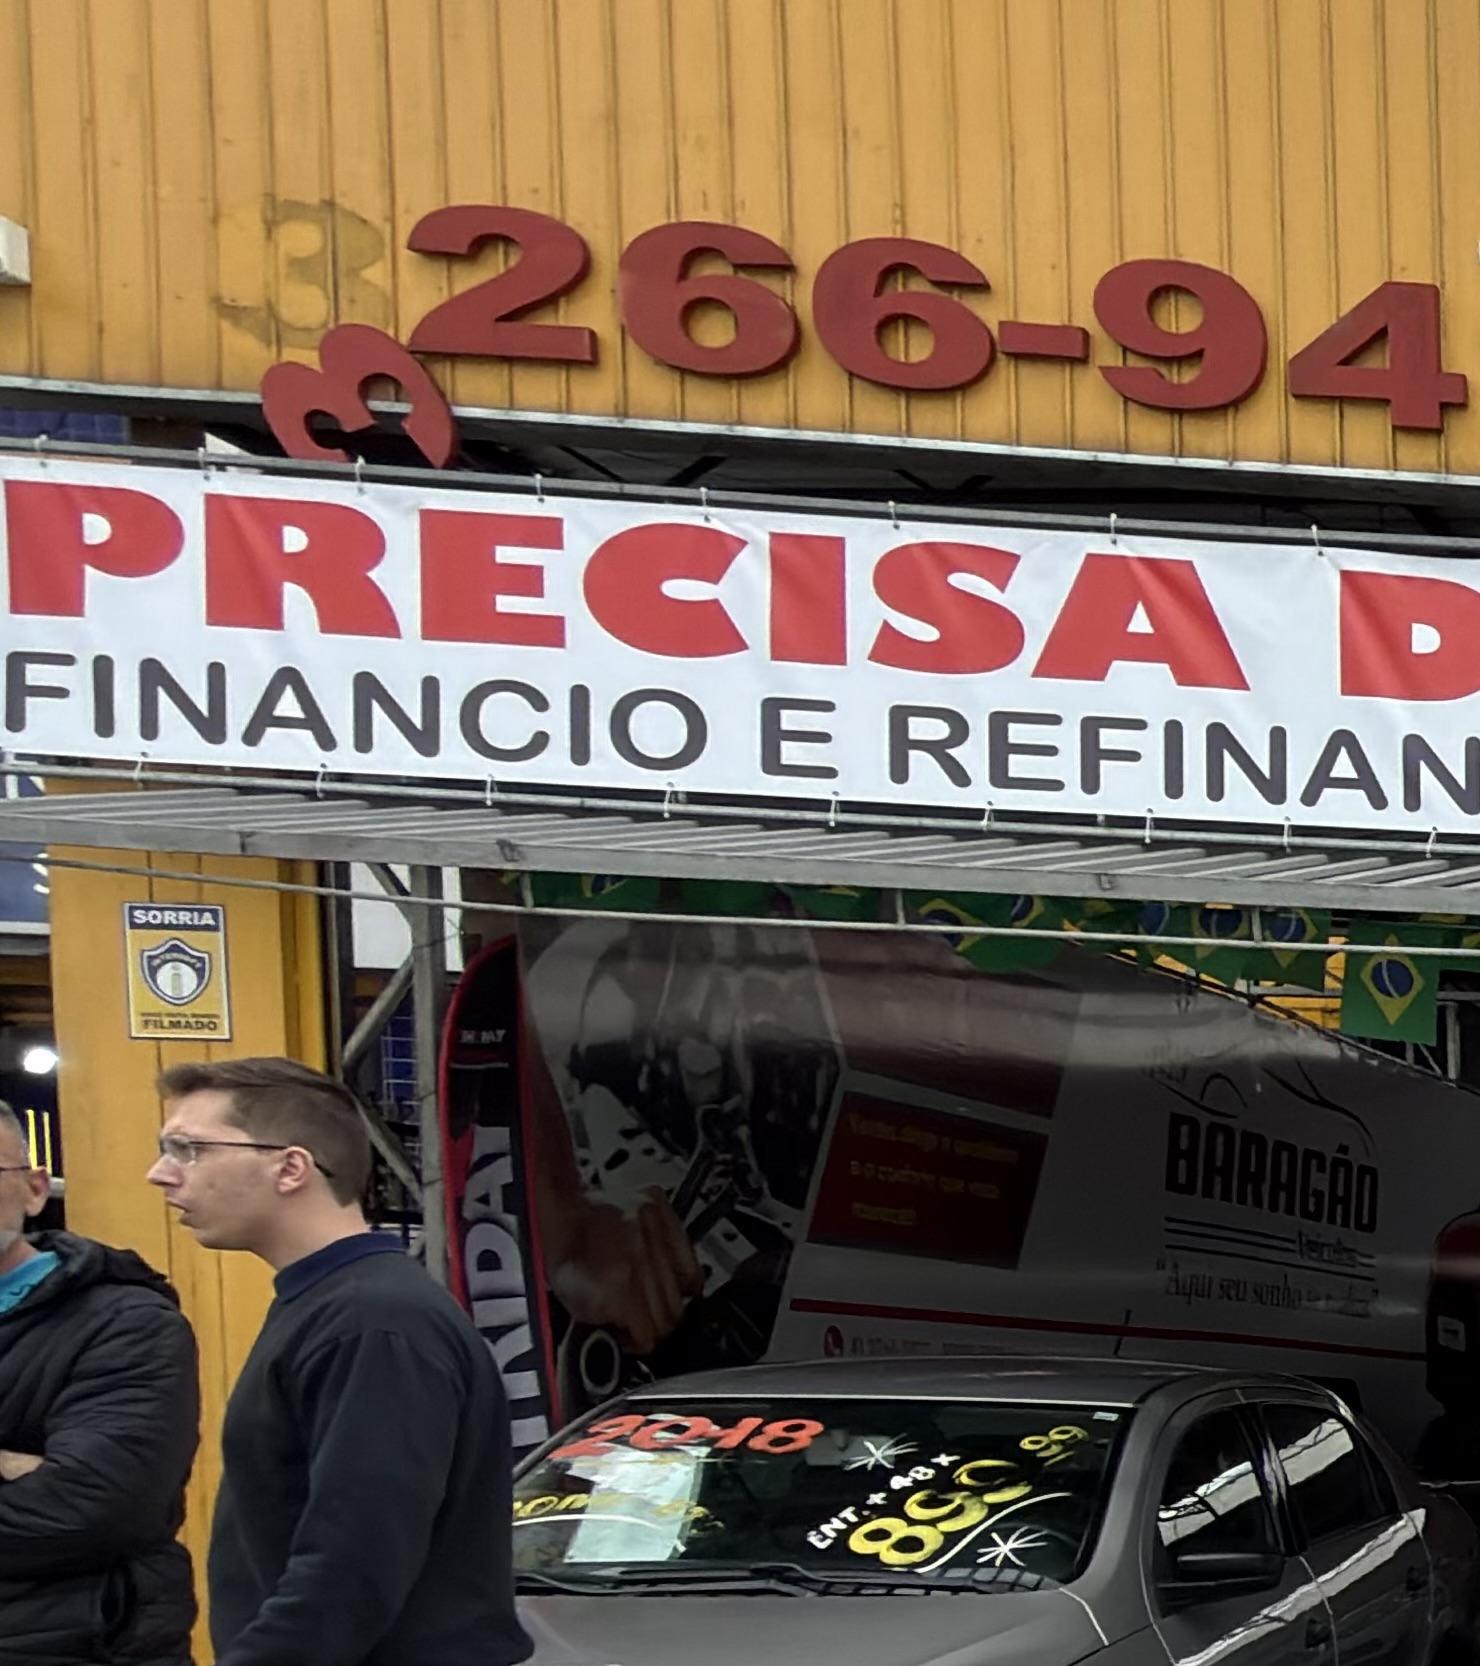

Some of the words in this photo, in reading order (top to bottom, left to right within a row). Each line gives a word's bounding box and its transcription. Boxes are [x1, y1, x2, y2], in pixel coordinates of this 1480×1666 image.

[5, 479, 1251, 691] PRECISA
[5, 650, 710, 772] FINANCIO
[760, 697, 838, 780] E
[132, 909, 216, 926] SORRIA
[142, 1018, 218, 1032] FILMADO
[1165, 1111, 1379, 1233] BARAGÃO
[547, 1414, 825, 1462] 2018
